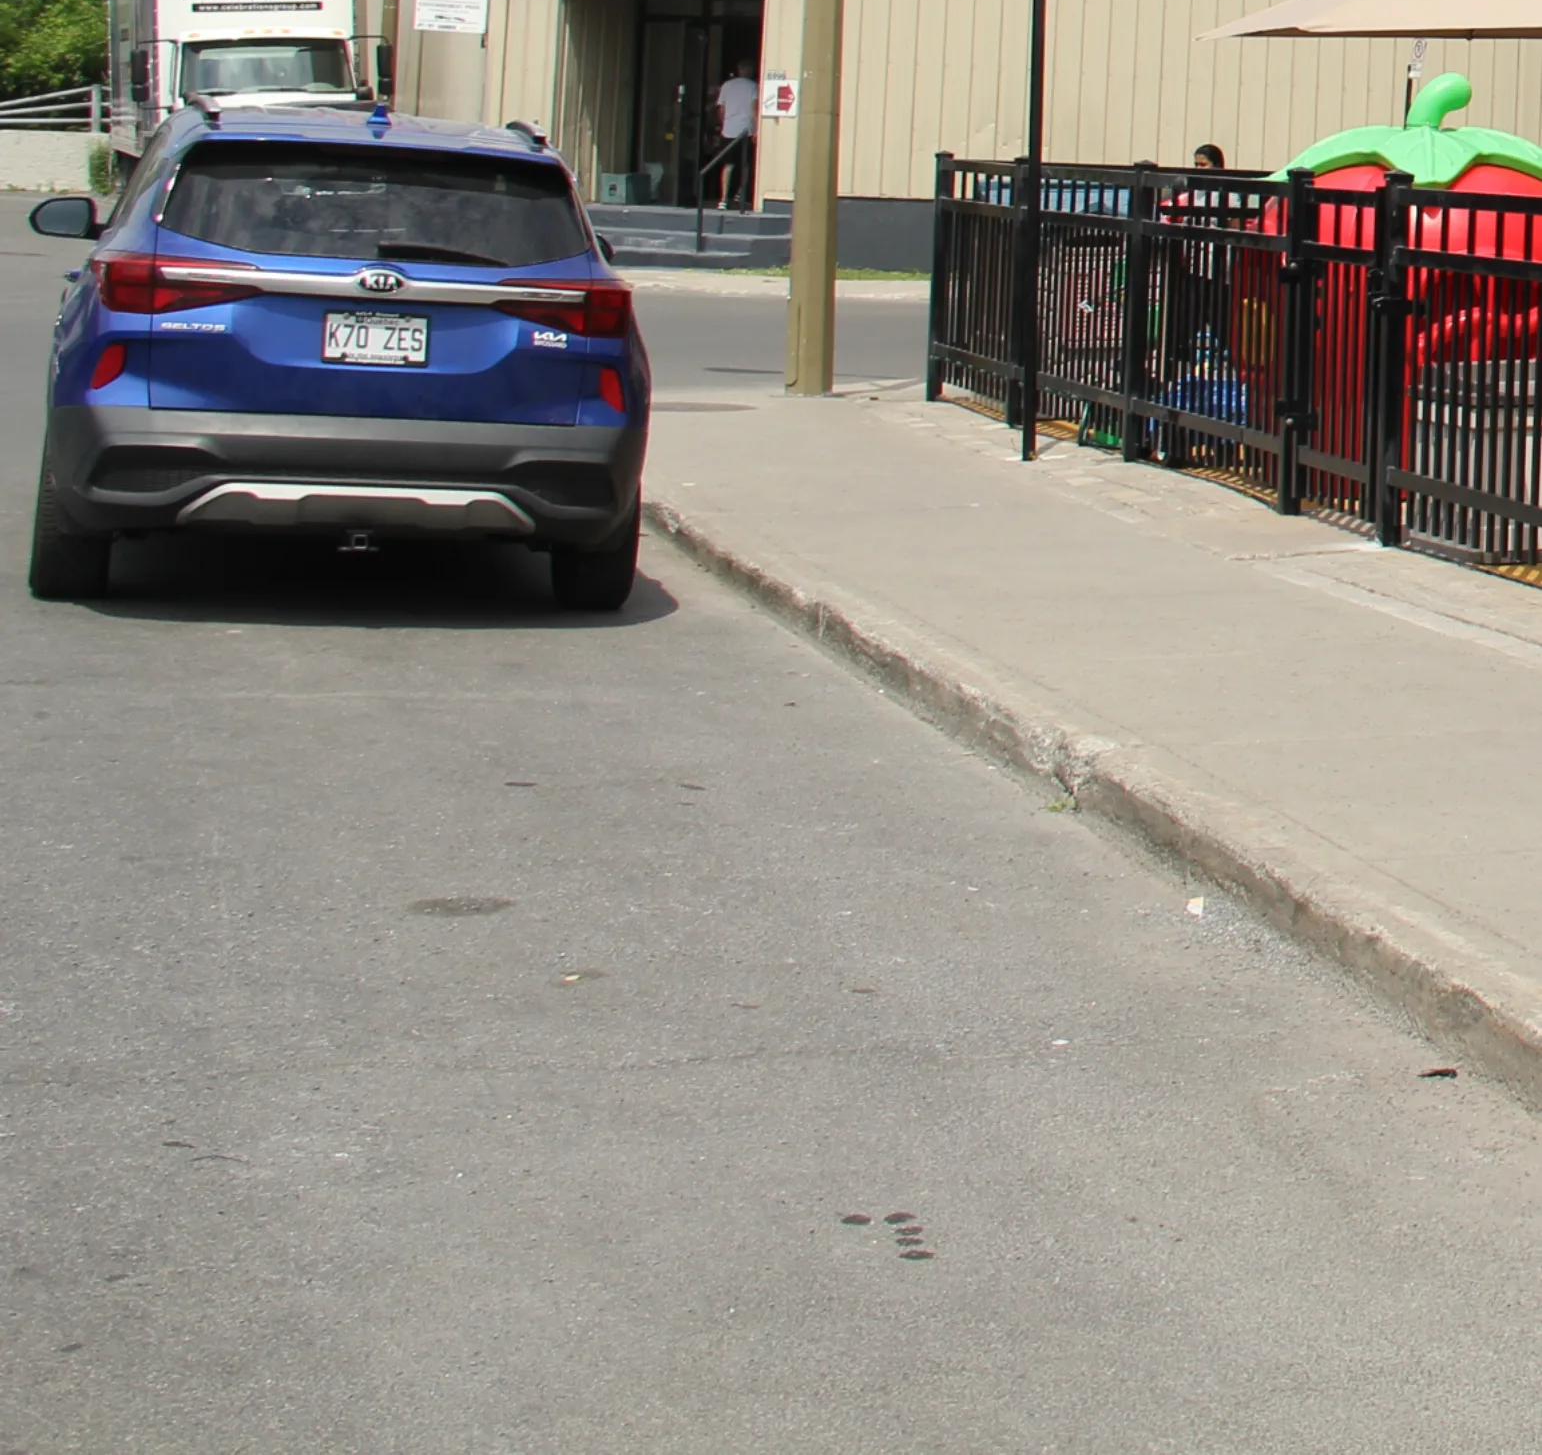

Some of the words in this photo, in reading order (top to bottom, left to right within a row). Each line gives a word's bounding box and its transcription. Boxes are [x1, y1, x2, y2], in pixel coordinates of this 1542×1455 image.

[198, 2, 318, 12] www.celebrationsgroup.com
[366, 275, 398, 290] KIA
[161, 322, 227, 332] SELTOS
[328, 323, 369, 349] K70
[383, 326, 424, 352] ZES
